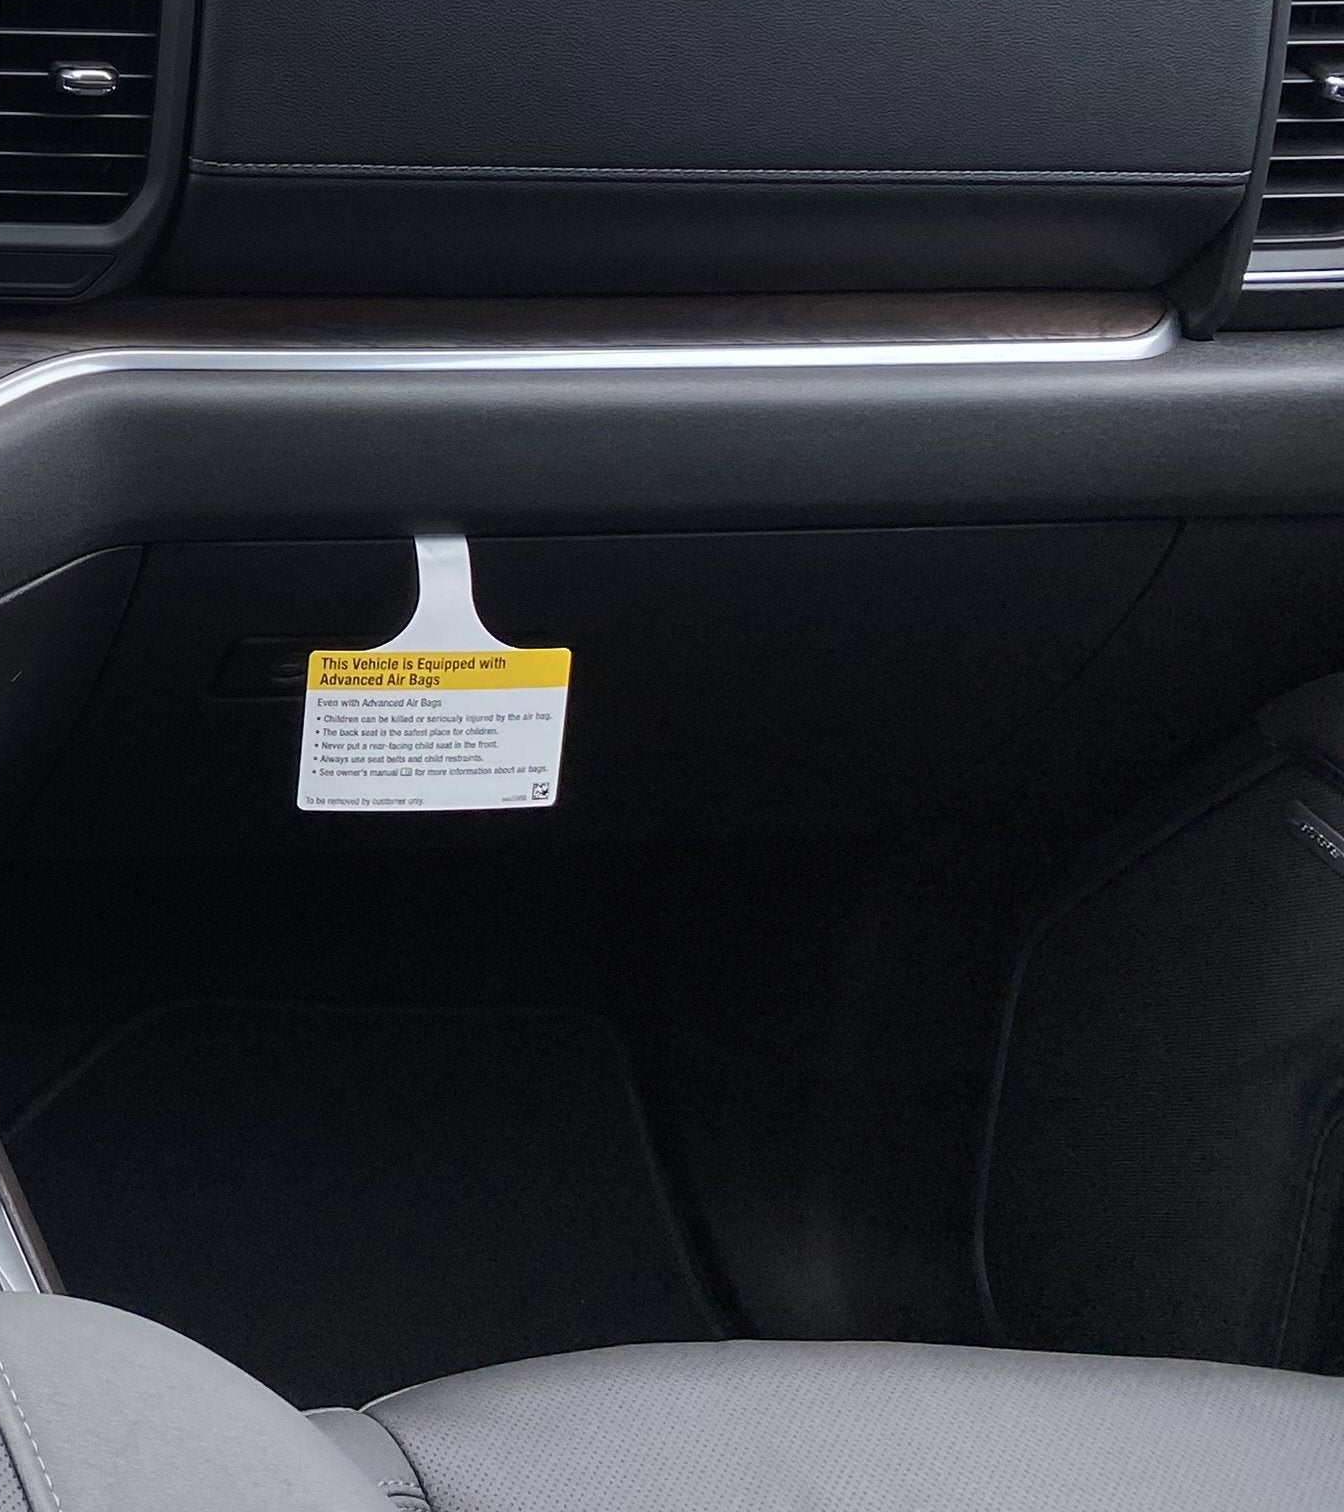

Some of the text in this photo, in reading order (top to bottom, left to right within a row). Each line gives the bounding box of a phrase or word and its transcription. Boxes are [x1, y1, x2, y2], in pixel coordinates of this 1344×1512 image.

[321, 656, 506, 673] This Vehicle is Equipped with
[320, 673, 440, 688] Advanced Air Bags
[317, 697, 442, 709] Even with Advanced Air Bags
[323, 714, 359, 723] Children
[378, 715, 389, 723] be
[391, 714, 414, 723] killed
[427, 714, 463, 724] seriously
[466, 713, 494, 724] injured
[495, 713, 506, 723] by
[508, 713, 521, 721] the
[522, 712, 534, 721] air
[323, 728, 337, 736] The
[339, 728, 359, 736] back
[361, 728, 378, 736] seat
[389, 728, 402, 736] the
[404, 727, 428, 736] safest
[429, 727, 451, 737] place
[452, 727, 464, 736] for
[321, 742, 345, 750] Never
[347, 742, 360, 751] put
[369, 742, 413, 751] rear-facing
[415, 742, 433, 750] child
[435, 741, 453, 749] seat
[454, 741, 462, 749] in
[464, 741, 476, 749] the
[320, 755, 349, 764] Always
[386, 755, 406, 763] belts
[407, 755, 422, 763] and
[424, 755, 443, 763] child
[319, 768, 334, 776] See
[336, 768, 368, 776] owner's
[370, 768, 398, 776] manual
[415, 768, 426, 776] for
[427, 768, 447, 776] more
[449, 767, 492, 776] information
[494, 766, 515, 774] about
[306, 796, 315, 804] To
[316, 796, 326, 804] be
[327, 797, 360, 805] removed
[361, 798, 370, 806] by
[372, 797, 407, 805] customer
